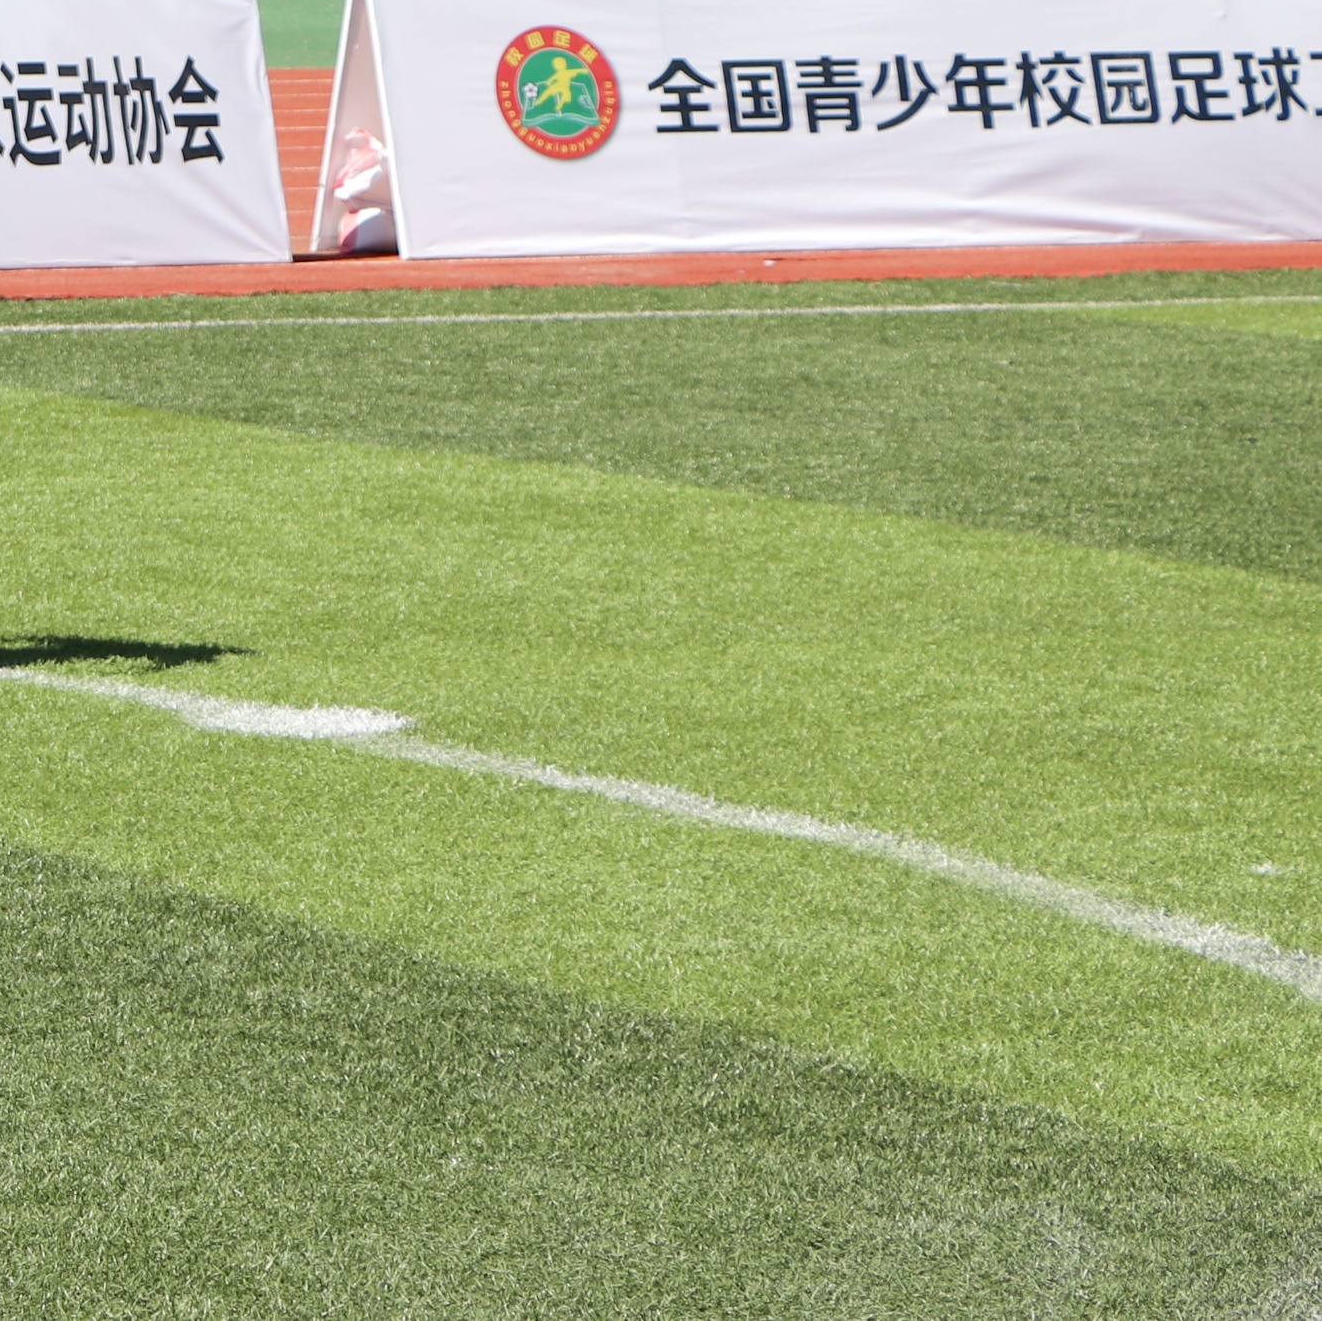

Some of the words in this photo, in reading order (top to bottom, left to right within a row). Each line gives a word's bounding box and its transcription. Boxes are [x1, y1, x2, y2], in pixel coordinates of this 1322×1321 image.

[505, 30, 598, 67] 校园足球
[501, 80, 616, 153] zhongguoxiaoyuanzuqiu
[648, 46, 1322, 133] 全国青少年校园足球
